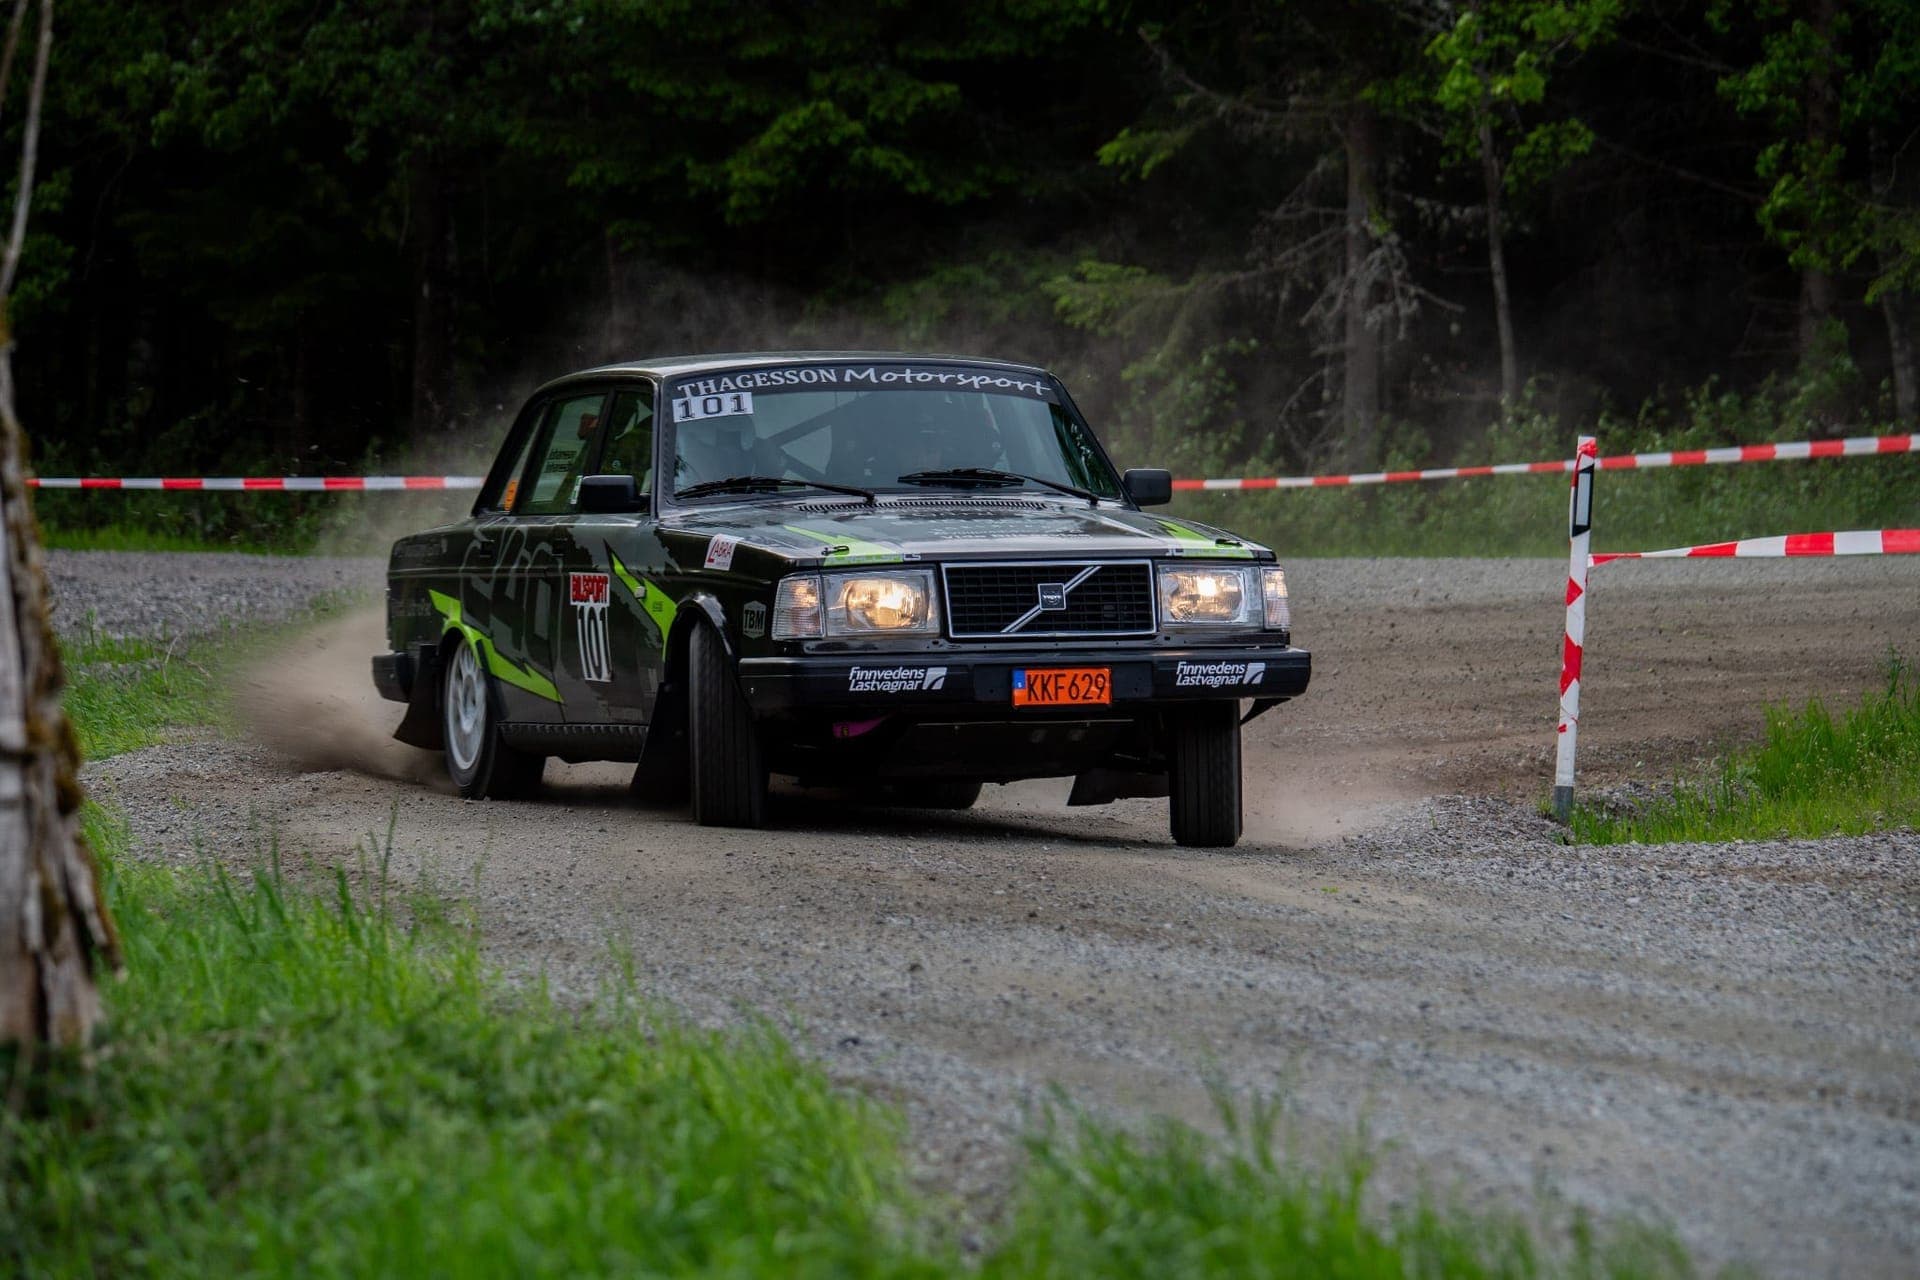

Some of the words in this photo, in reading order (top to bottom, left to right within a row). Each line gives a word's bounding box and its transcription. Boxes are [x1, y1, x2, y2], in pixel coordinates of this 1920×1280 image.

[677, 369, 837, 397] THAGESSON
[843, 367, 1051, 395] Motorsport
[678, 395, 748, 420] 101
[744, 609, 764, 629] TBM
[578, 606, 613, 679] 101
[849, 666, 925, 681] Finnvedens
[1176, 661, 1245, 676] Finnvedens
[849, 678, 922, 693] Lastvagnar
[1176, 673, 1243, 688] Lastvagnar
